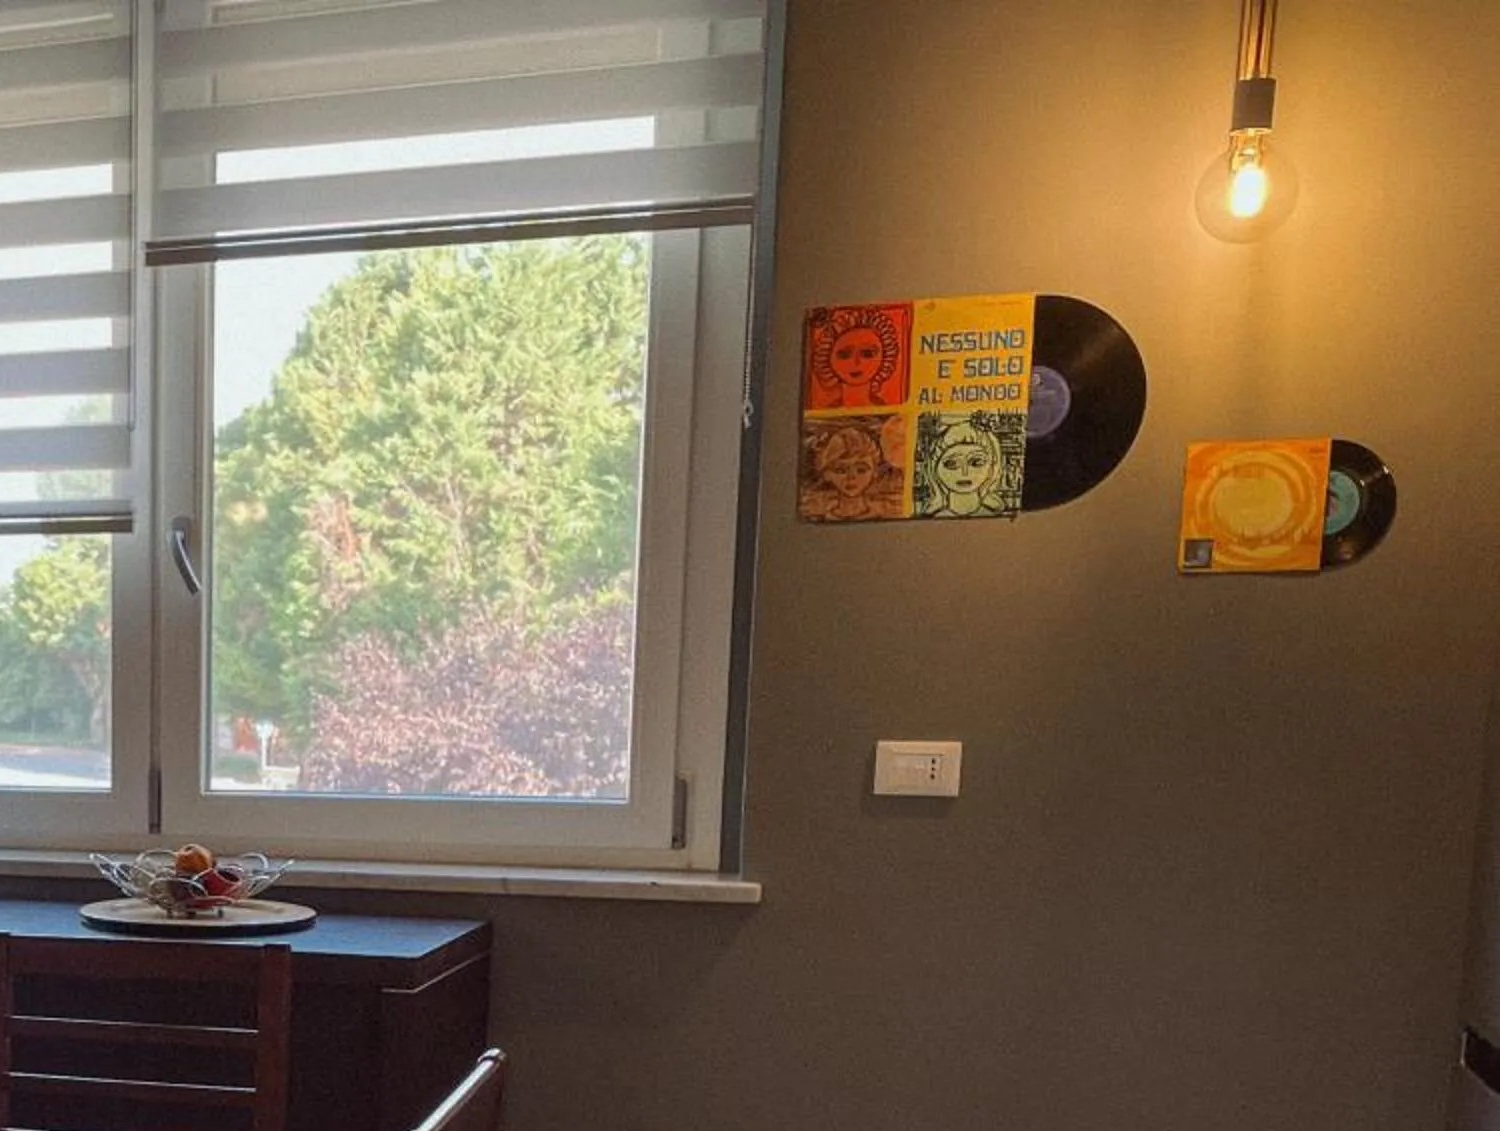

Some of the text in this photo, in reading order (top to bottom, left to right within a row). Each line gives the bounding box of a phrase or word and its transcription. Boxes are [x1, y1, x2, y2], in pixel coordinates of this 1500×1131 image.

[919, 330, 1024, 354] NESSUNO
[963, 356, 1023, 378] SOLO
[951, 383, 1021, 402] MONDO
